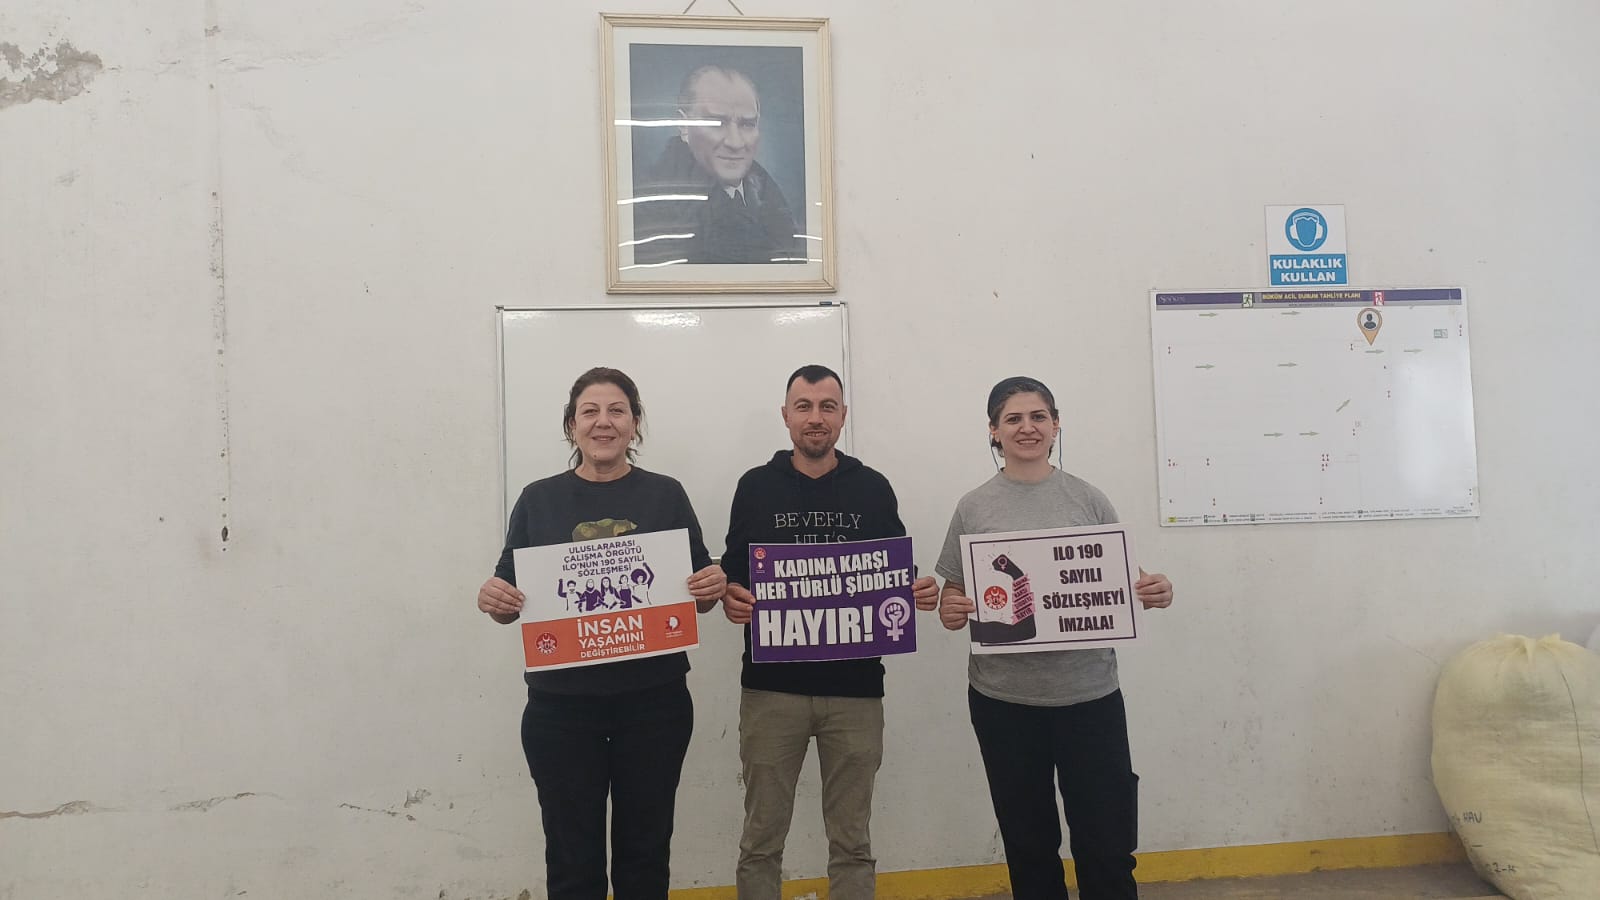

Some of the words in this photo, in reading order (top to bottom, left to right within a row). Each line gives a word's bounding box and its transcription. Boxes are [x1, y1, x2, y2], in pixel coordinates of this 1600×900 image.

[1273, 258, 1342, 269] KULAKLIK
[1281, 271, 1336, 282] KULLAN
[563, 552, 603, 565] ÇALIŞMA
[605, 546, 642, 558] ÖRGÜTÜ
[568, 540, 635, 554] ULUSLARARASI
[1053, 545, 1075, 561] ILO
[1076, 543, 1103, 559] 190
[562, 560, 599, 572] ILO'NUN
[601, 558, 616, 567] 190
[618, 554, 645, 565] SAYILI
[577, 564, 632, 578] SÖZLEŞMESİ
[773, 556, 837, 578] KADINA
[839, 550, 888, 571] KARŞI
[755, 582, 787, 601] HER
[789, 574, 842, 599] TÜRLÜ
[845, 568, 910, 597] ŞİDDETE
[1059, 567, 1102, 584] SAYILI
[1042, 587, 1125, 610] SÖZLEŞMEYİ
[577, 614, 644, 637] İNSAN
[758, 605, 874, 647] HAYIR!
[1058, 615, 1114, 632] İMZALA!
[578, 631, 644, 650] YAŞAMINI
[580, 644, 646, 658] DEĞİŞTİREBİLİR
